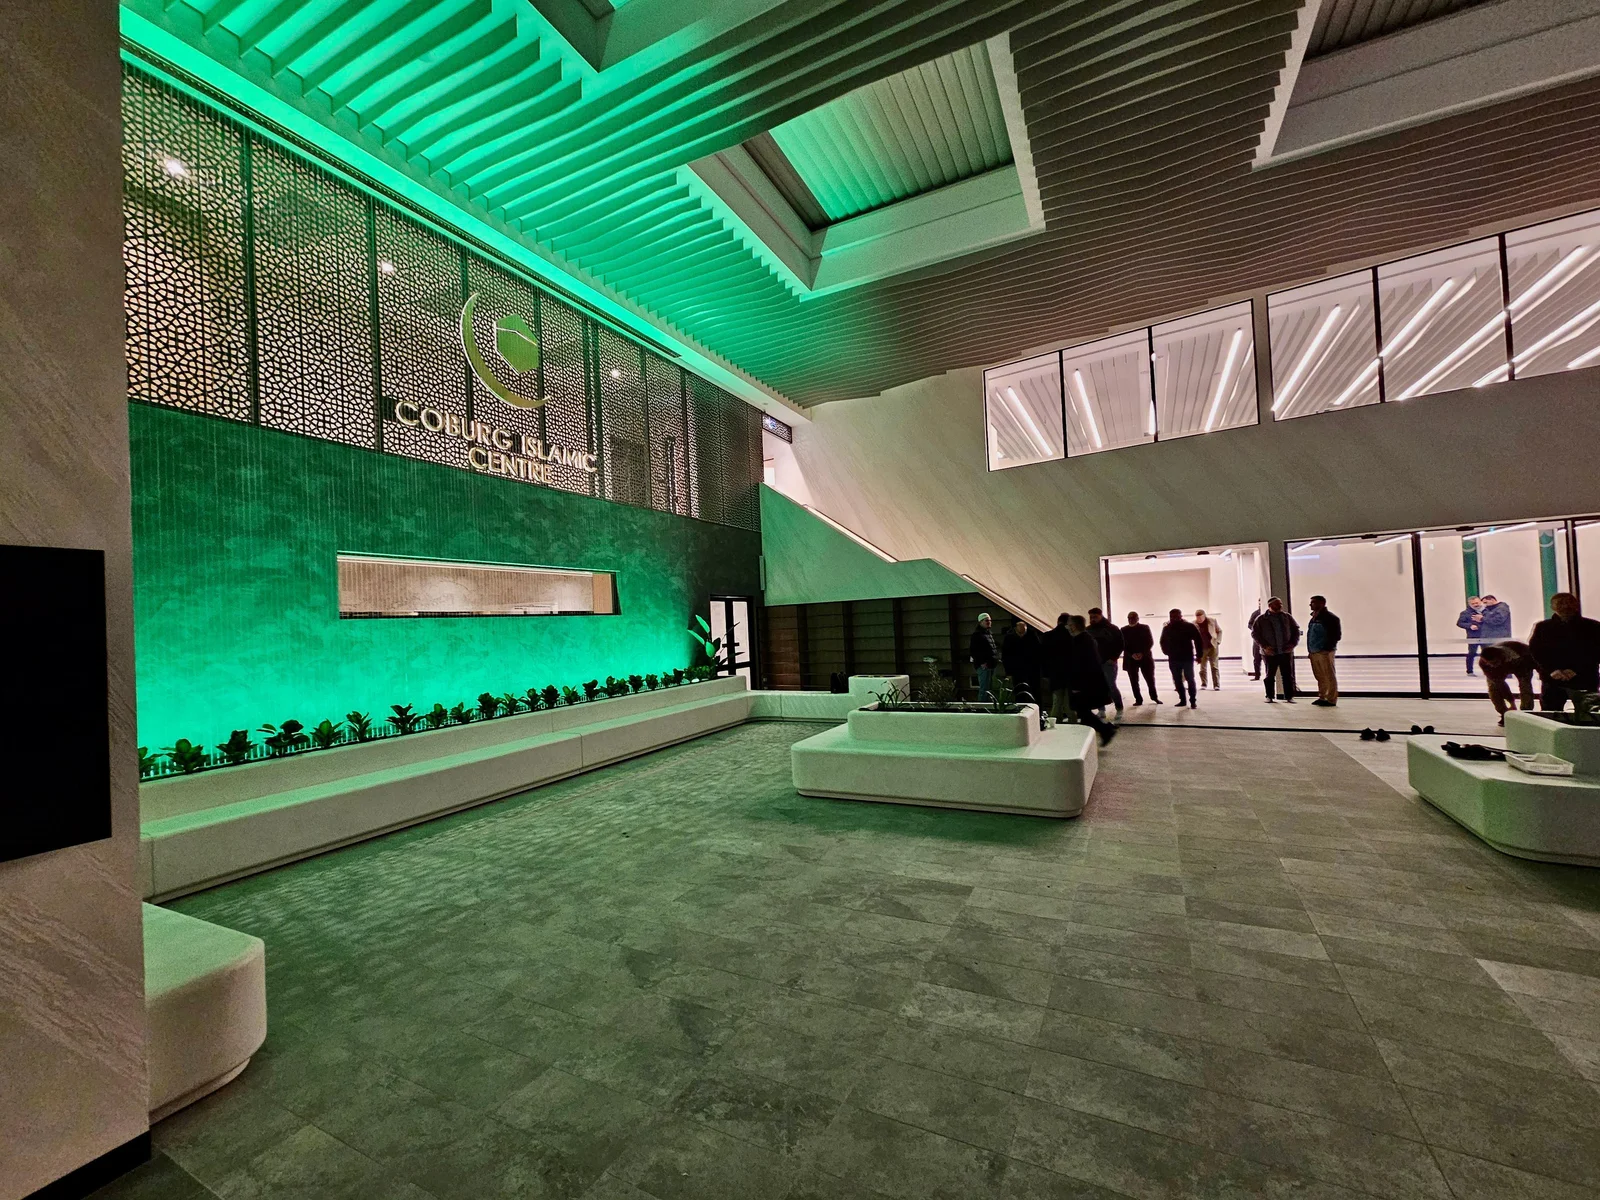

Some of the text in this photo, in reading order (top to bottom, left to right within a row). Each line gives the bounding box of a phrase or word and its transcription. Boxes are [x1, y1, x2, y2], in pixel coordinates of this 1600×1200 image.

[395, 400, 597, 472] COBURG ISLAMIC
[468, 446, 553, 484] CENTRE
